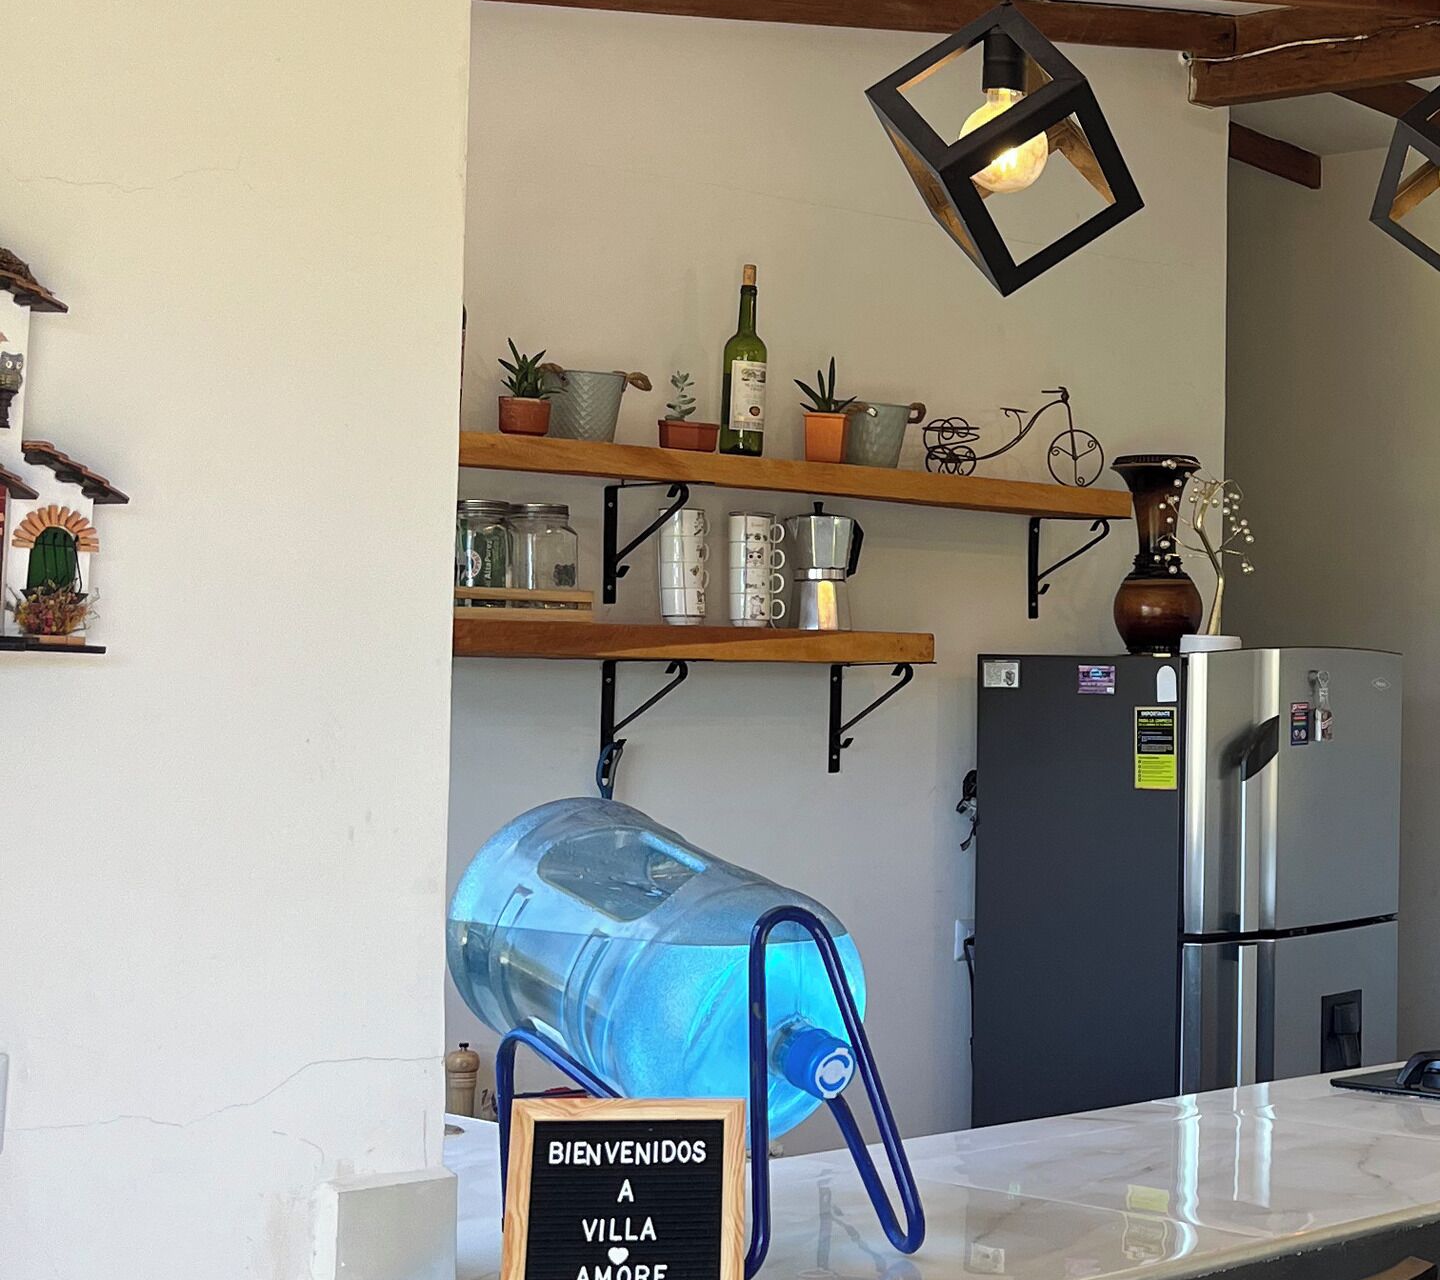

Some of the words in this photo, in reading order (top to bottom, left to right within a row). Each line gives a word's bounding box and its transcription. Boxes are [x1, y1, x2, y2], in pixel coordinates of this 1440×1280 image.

[548, 1140, 706, 1165] BIENVENIDOS
[617, 1178, 635, 1203] A
[582, 1216, 657, 1242] VILLA
